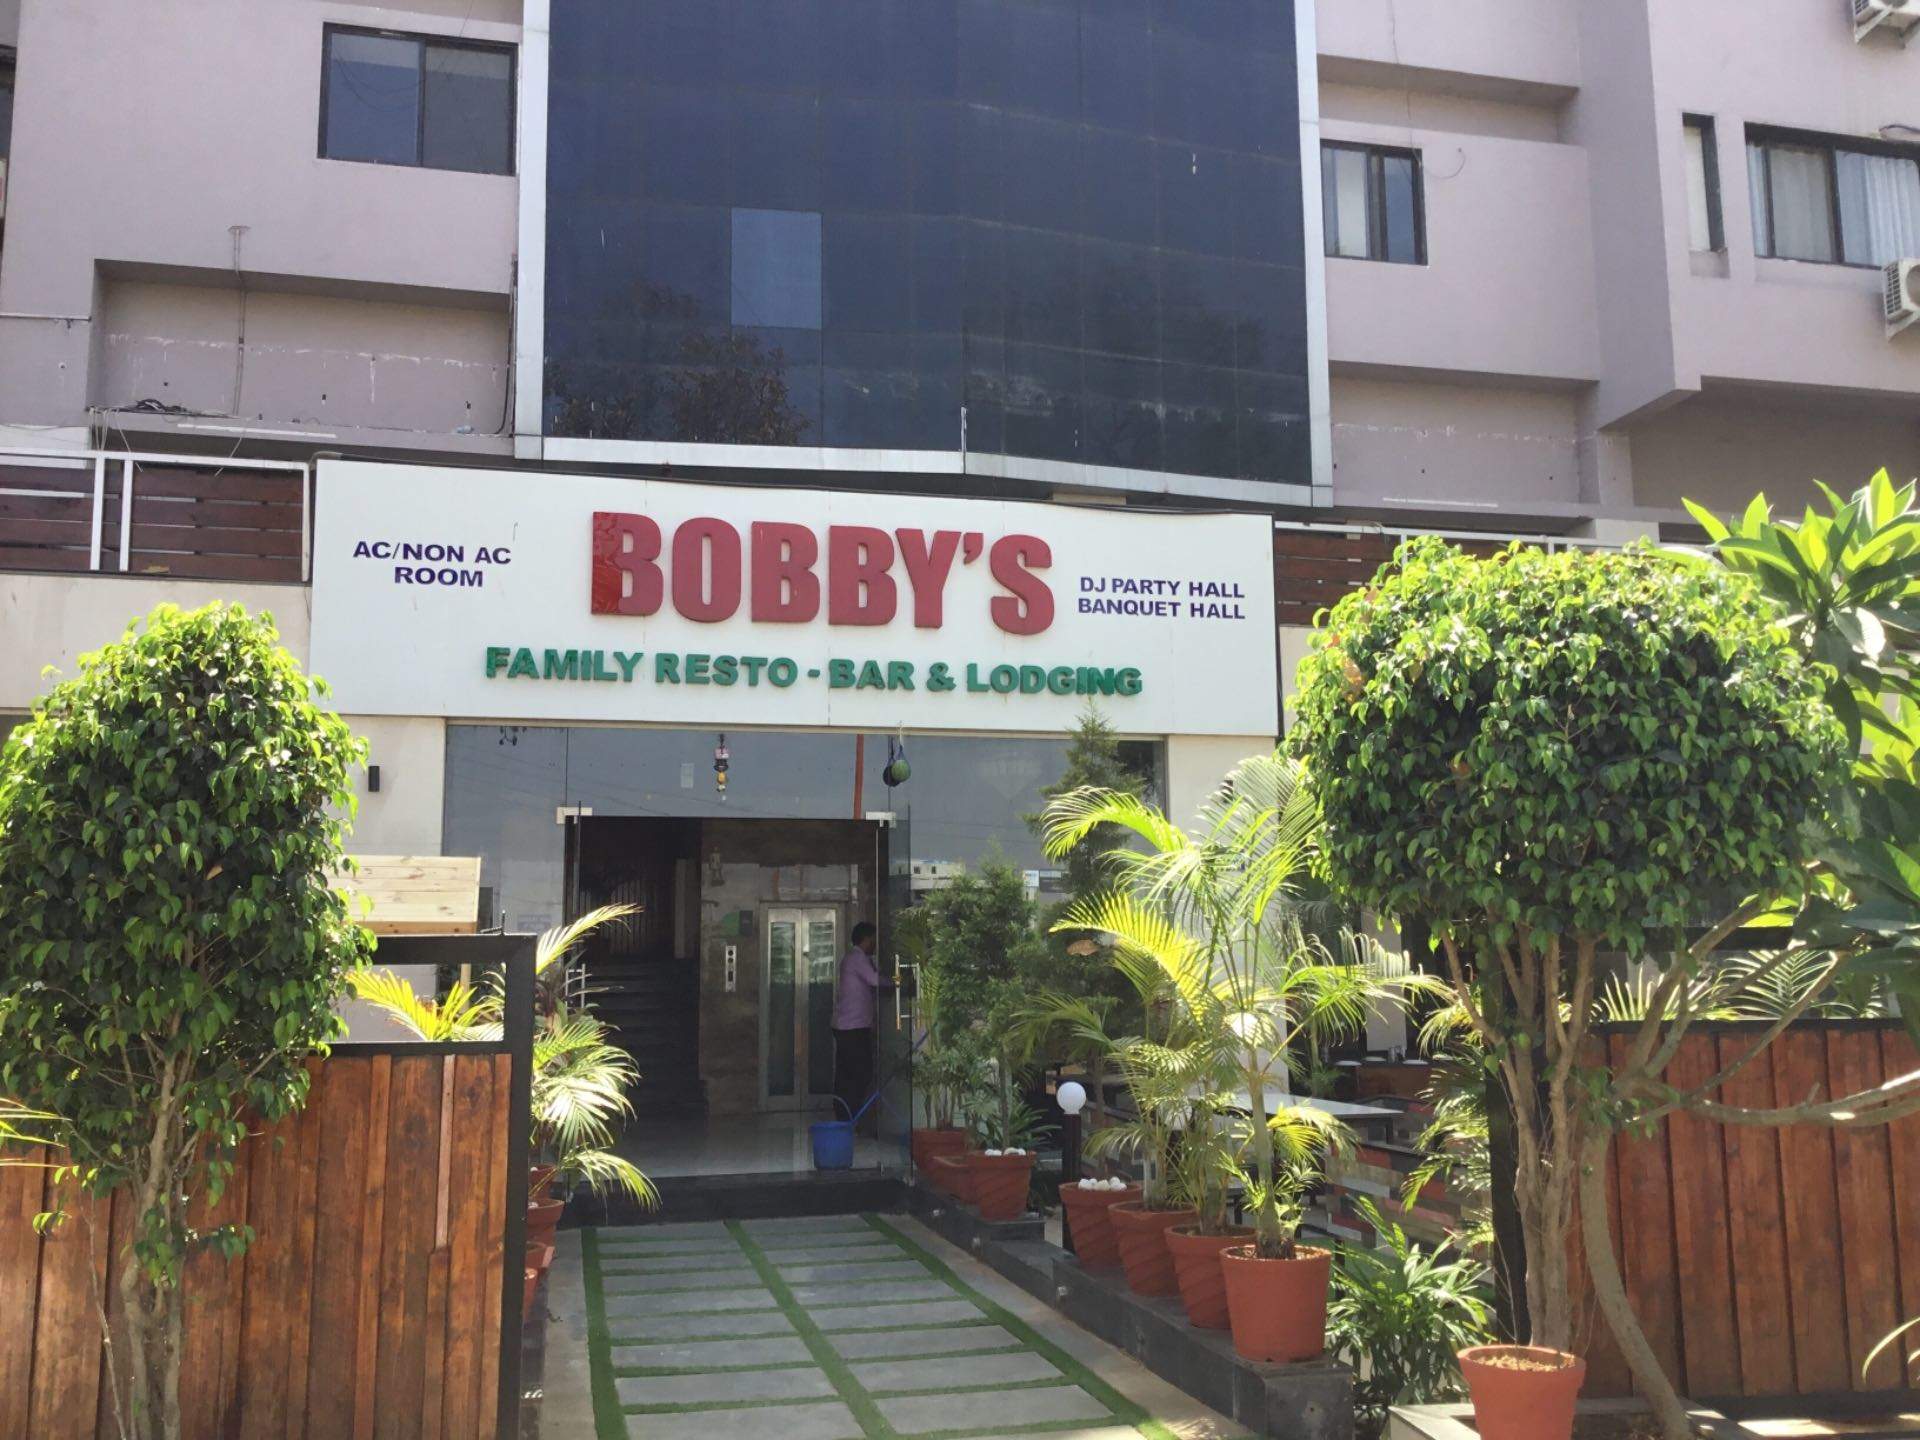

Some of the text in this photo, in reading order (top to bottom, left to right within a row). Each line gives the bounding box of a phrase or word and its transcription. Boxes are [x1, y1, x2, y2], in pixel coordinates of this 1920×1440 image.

[353, 541, 511, 565] AC/NON AC
[394, 566, 484, 587] ROOM
[590, 511, 1055, 636] BOBBY'S
[1080, 576, 1245, 599] DJ PARTY HALL
[1078, 597, 1245, 619] BANQUET HALL
[485, 646, 644, 682] FAMILY
[655, 652, 799, 688] RESTO
[828, 658, 915, 690] BAR
[926, 662, 957, 691] &
[966, 662, 1143, 696] LODGING
